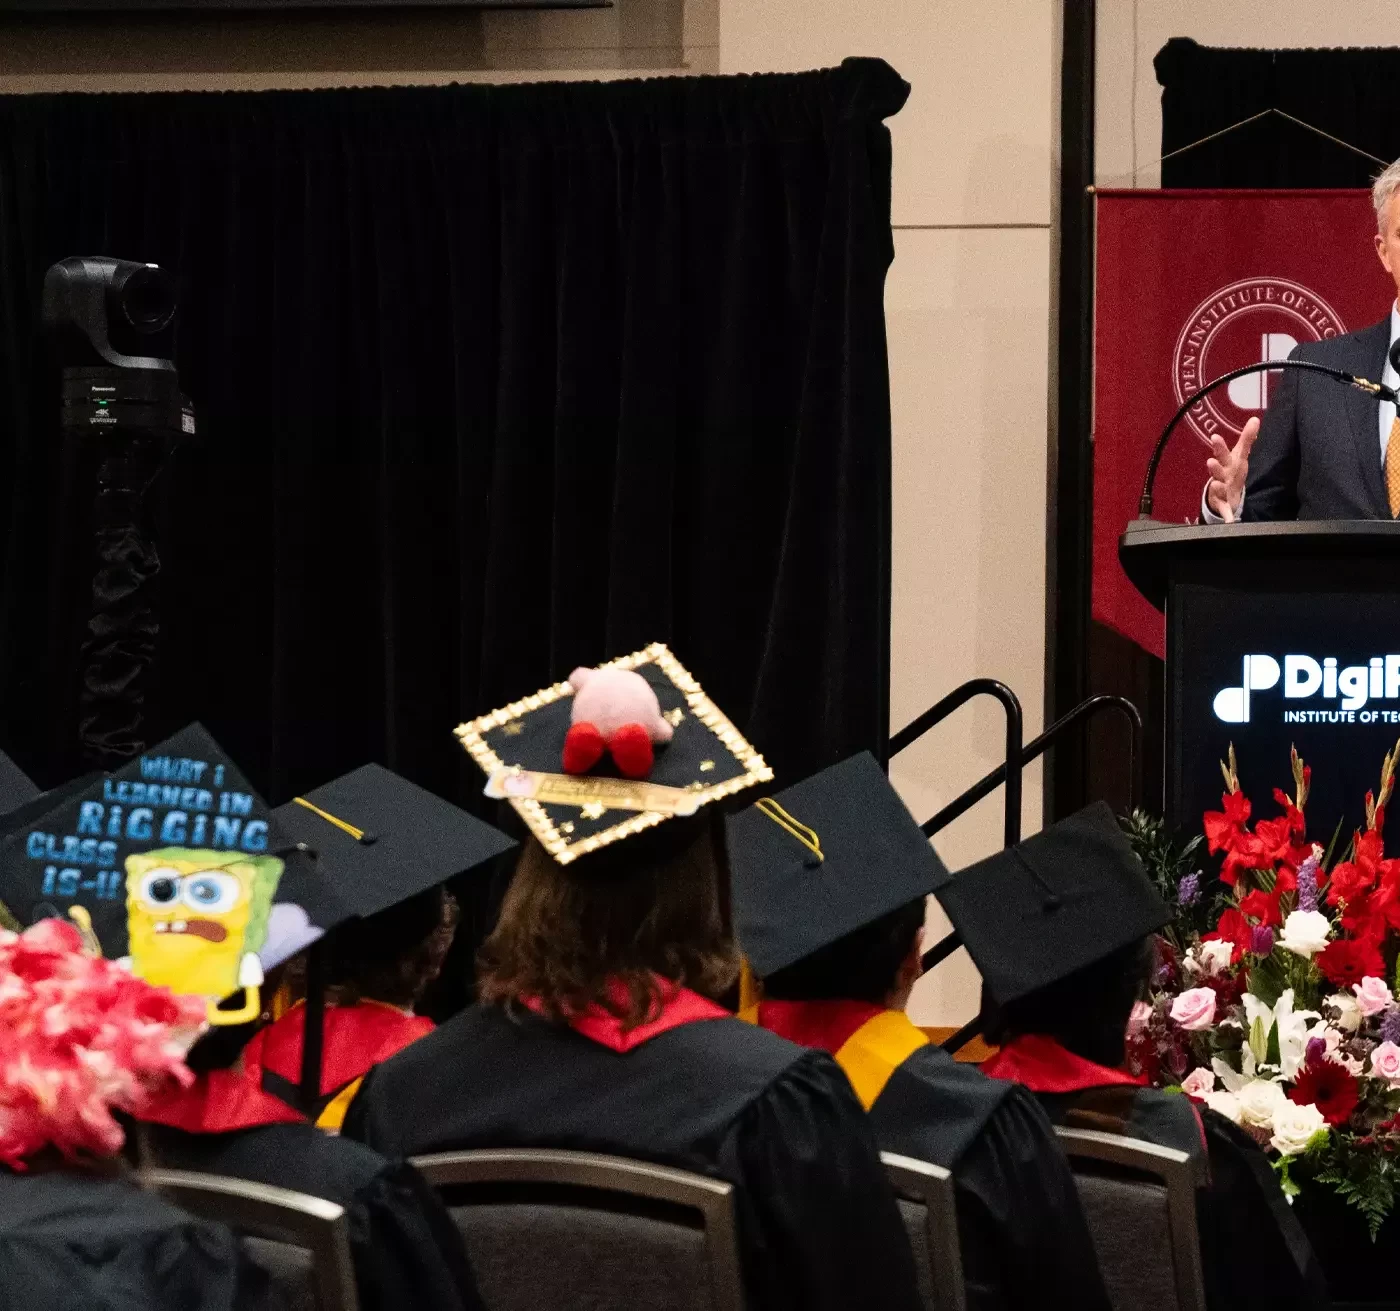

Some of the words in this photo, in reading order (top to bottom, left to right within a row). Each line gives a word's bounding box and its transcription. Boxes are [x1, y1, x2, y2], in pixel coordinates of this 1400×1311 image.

[1188, 287, 1275, 346] INSTITUTE
[1282, 290, 1306, 309] OF
[1182, 354, 1220, 434] DIGPEN
[1284, 711, 1355, 723] INSTITUTE
[1359, 711, 1379, 723] OF
